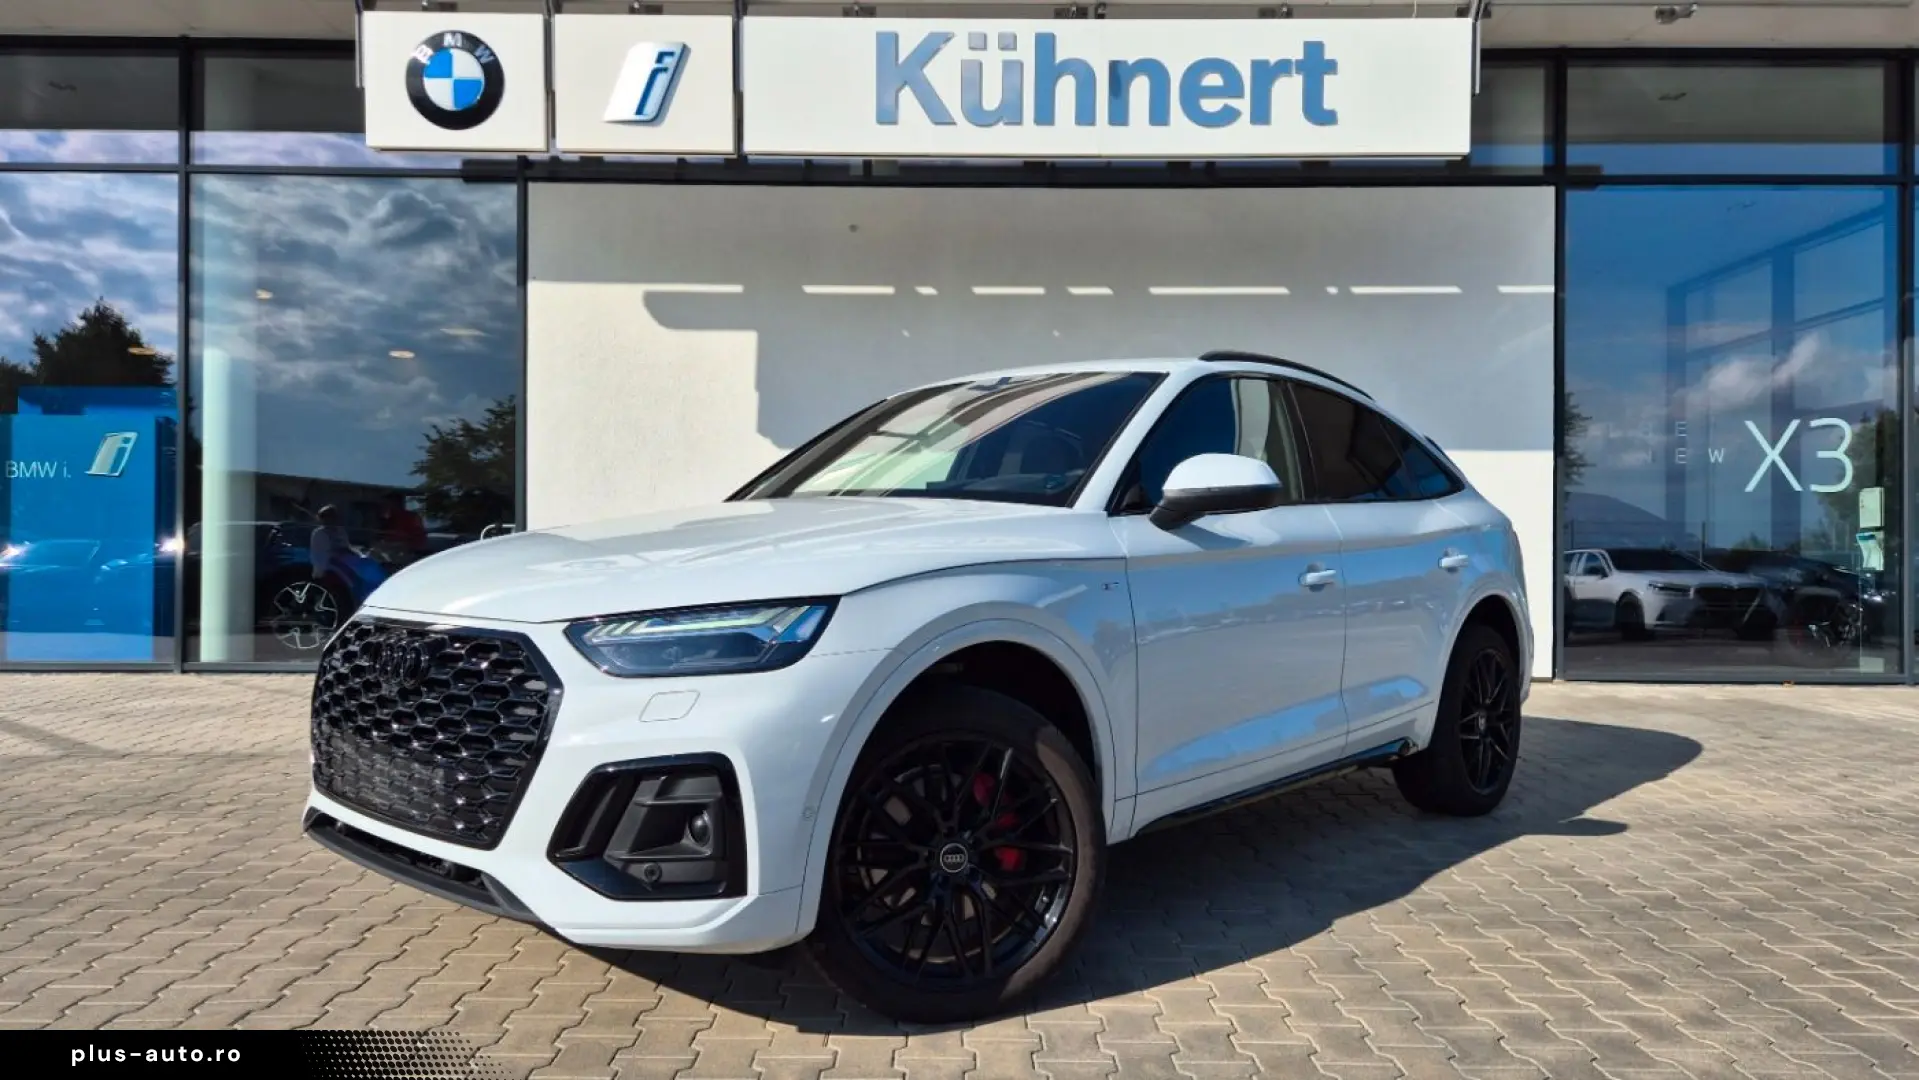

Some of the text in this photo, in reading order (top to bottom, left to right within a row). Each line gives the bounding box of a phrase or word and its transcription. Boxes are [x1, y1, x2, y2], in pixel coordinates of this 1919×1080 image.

[409, 32, 496, 65] BMW
[875, 31, 1338, 128] Kühnert
[5, 460, 57, 478] BMW
[1744, 418, 1853, 492] X3
